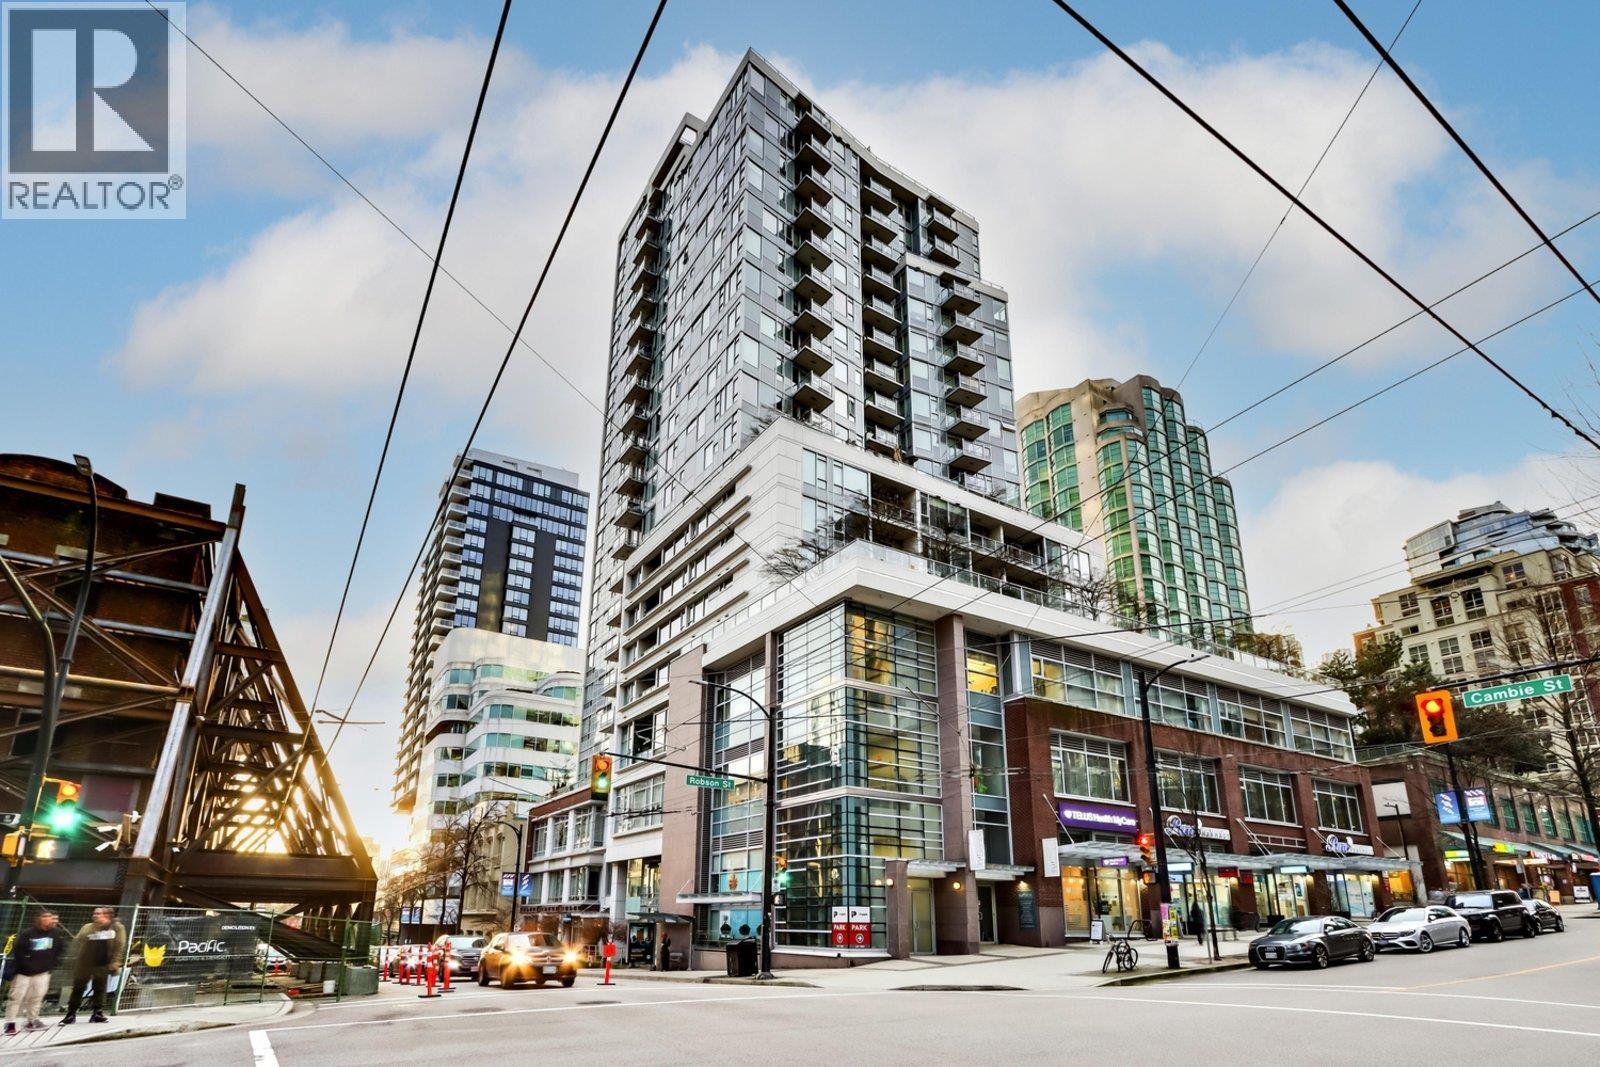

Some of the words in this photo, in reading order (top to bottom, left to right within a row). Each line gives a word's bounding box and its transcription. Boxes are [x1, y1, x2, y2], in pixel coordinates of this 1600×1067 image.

[1470, 686, 1535, 704] Cambie
[1543, 679, 1564, 692] St
[689, 776, 720, 787] Robson
[722, 780, 732, 788] St
[1071, 810, 1094, 821] TELUS
[178, 939, 226, 953] Pacific
